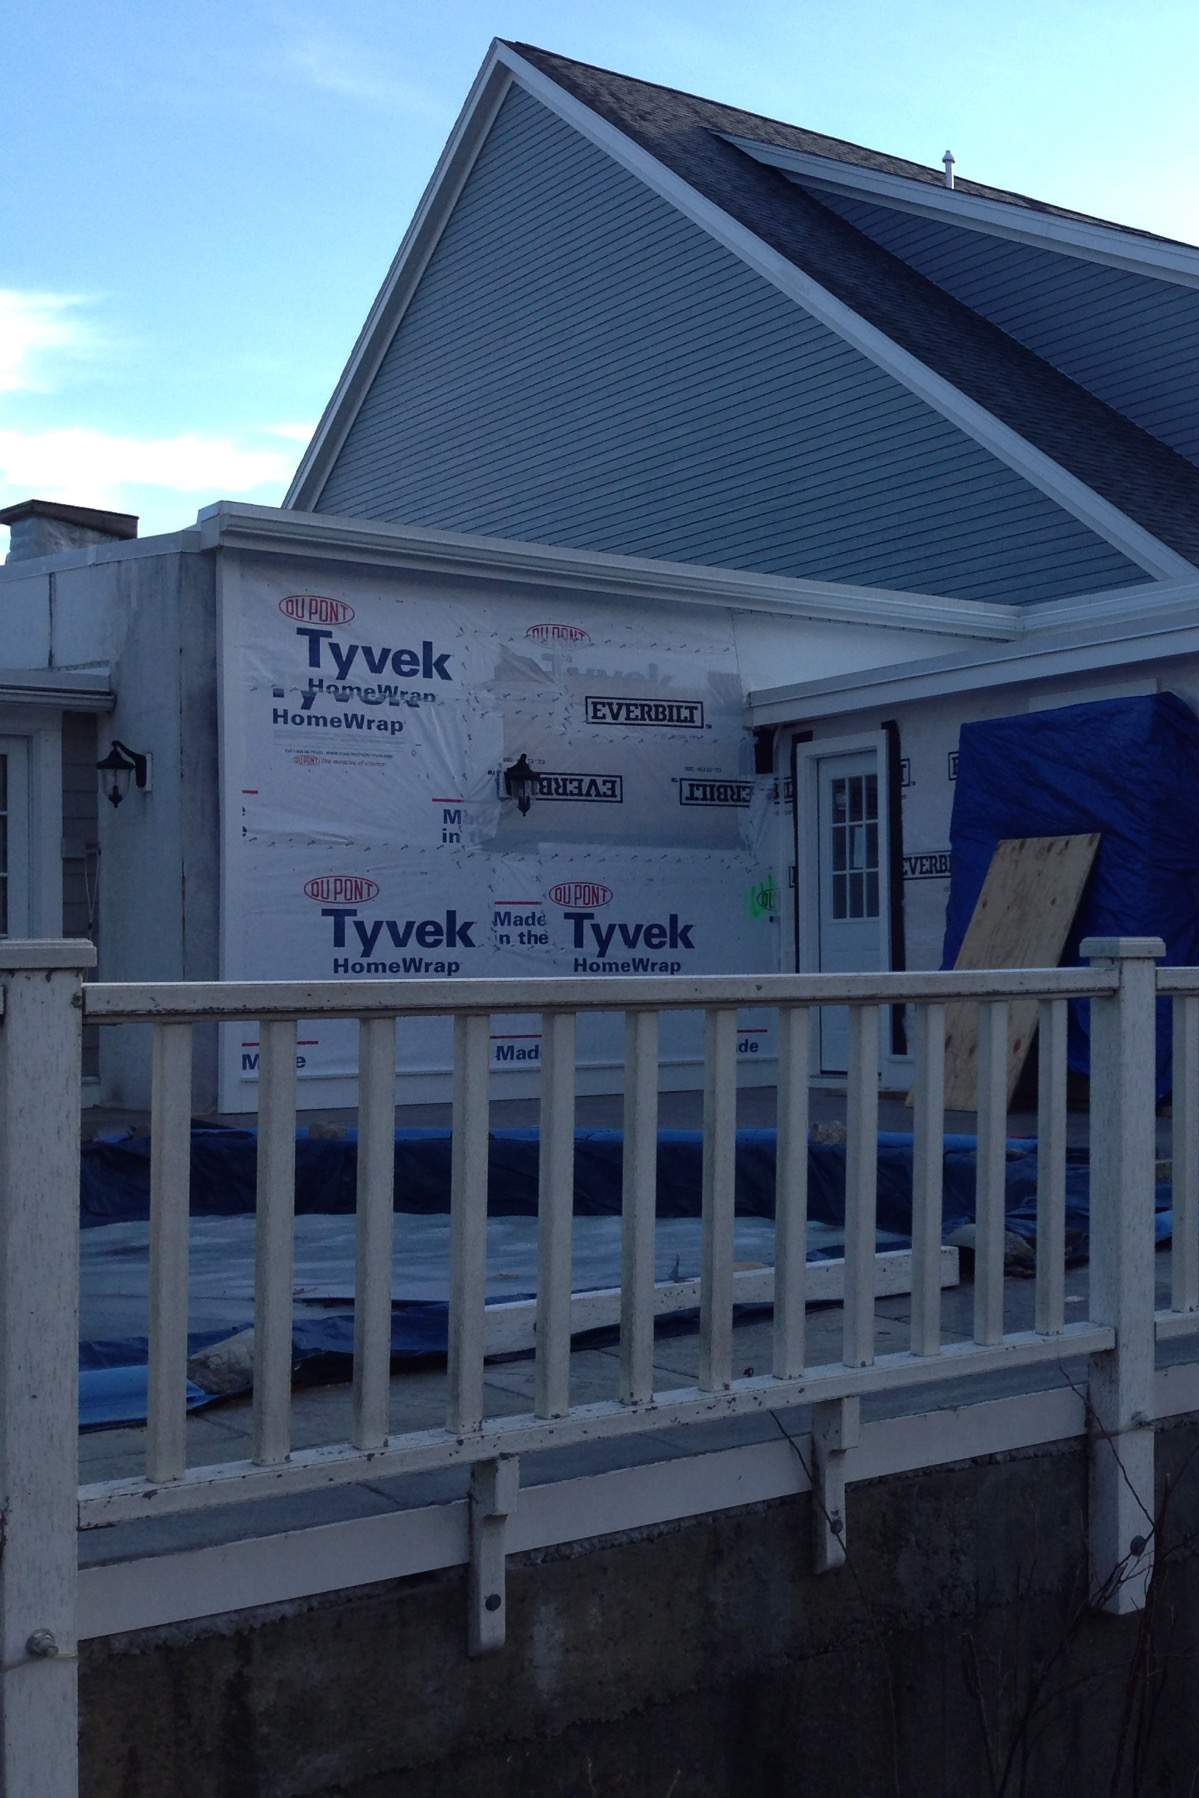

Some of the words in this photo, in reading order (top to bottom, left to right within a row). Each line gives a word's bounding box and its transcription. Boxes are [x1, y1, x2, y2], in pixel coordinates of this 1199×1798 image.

[296, 627, 453, 681] Tyvek
[272, 708, 404, 735] HomeWrap
[591, 700, 699, 724] EVERBILT
[685, 784, 753, 803] ERBILT
[494, 911, 546, 927] Made
[321, 908, 477, 958] Tyvek
[518, 930, 549, 945] the
[563, 912, 696, 958] Tyvek
[333, 957, 461, 977] HomeWrap
[573, 957, 682, 975] HomeWrap
[241, 1053, 306, 1071] Me
[496, 1044, 540, 1061] Mad
